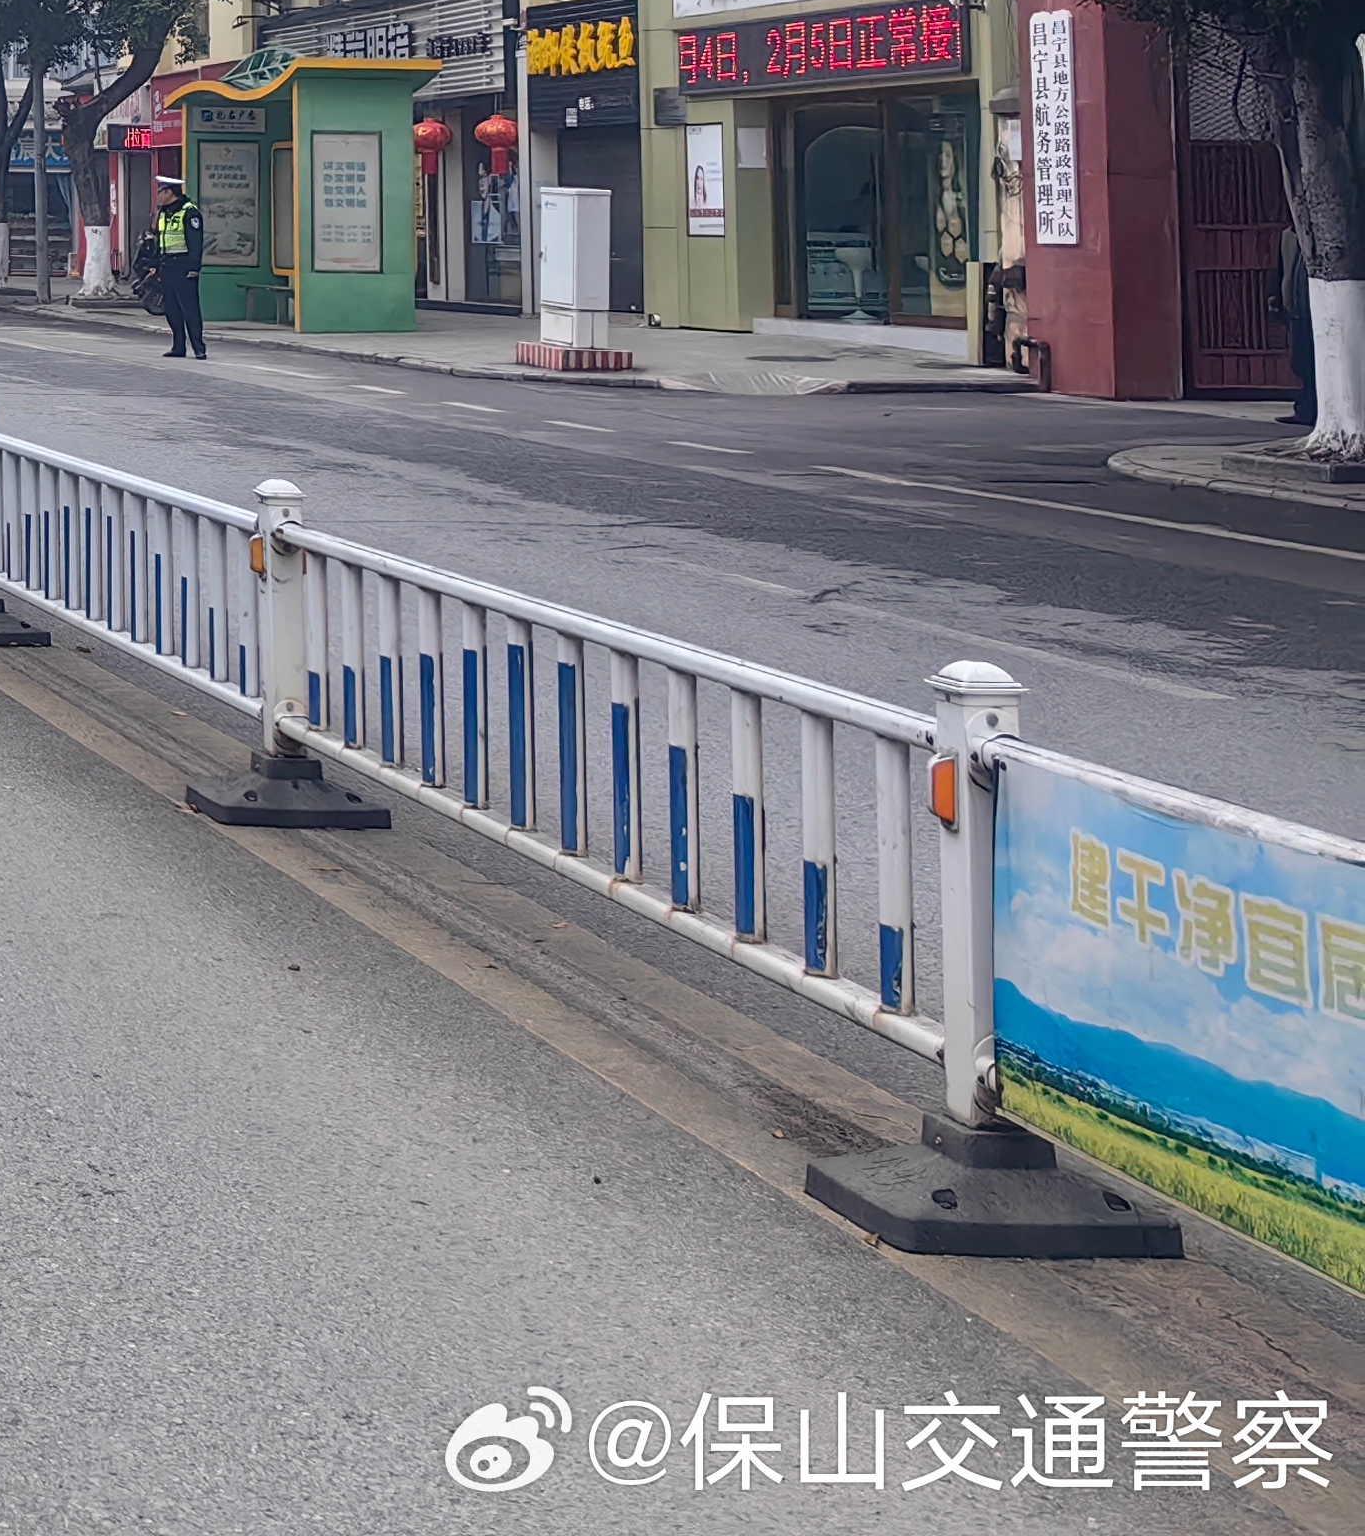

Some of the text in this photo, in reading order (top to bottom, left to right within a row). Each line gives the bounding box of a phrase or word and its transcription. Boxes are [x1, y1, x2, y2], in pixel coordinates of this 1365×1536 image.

[1032, 22, 1055, 235] 昌宁县航务管理所
[1051, 19, 1075, 238] 昌宁县地方公路路政管理大队
